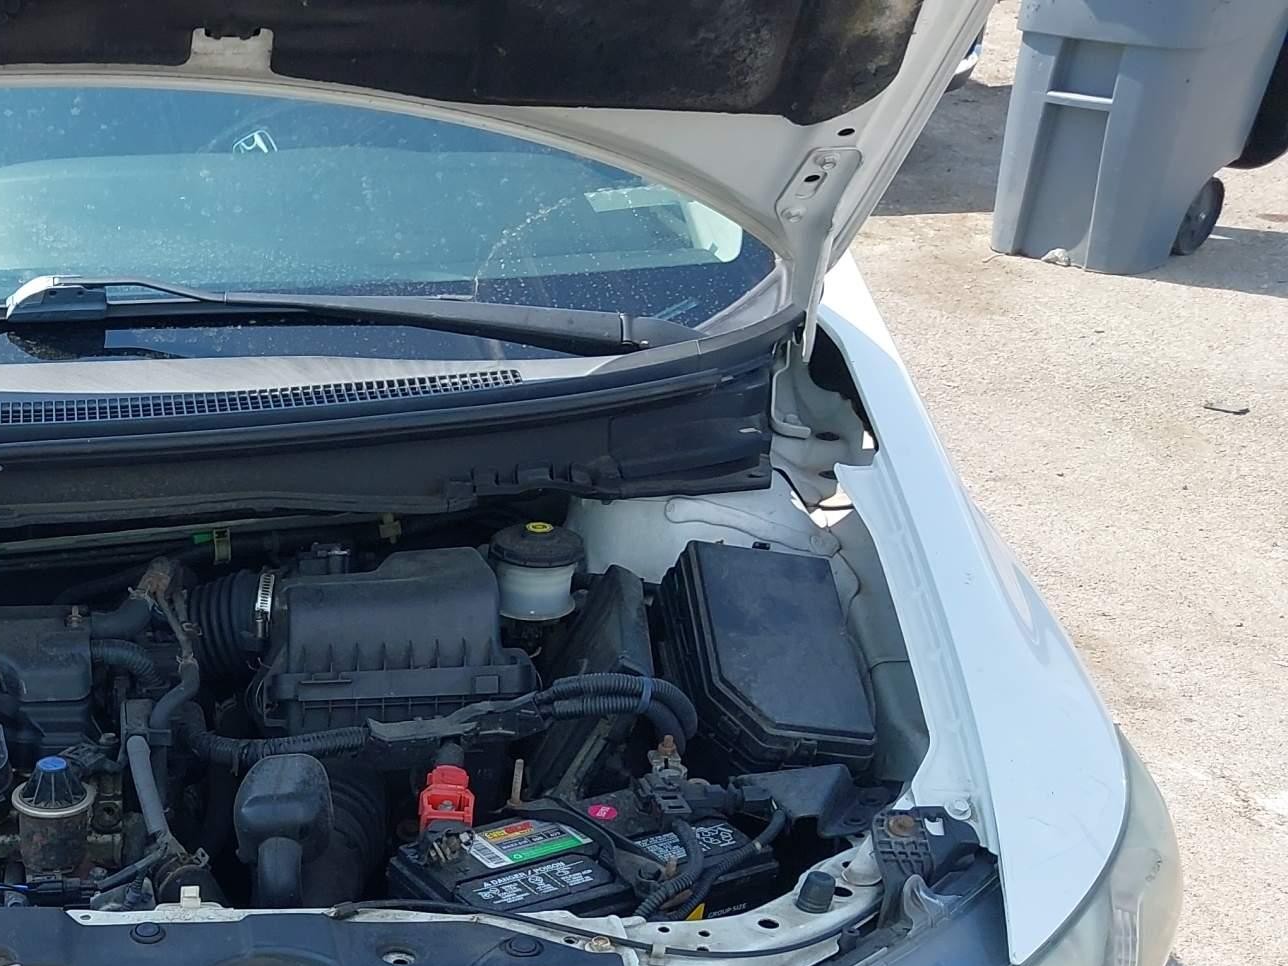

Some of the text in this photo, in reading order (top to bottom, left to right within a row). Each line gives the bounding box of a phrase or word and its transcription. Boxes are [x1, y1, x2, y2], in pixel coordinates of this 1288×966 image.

[533, 861, 566, 876] POISON
[707, 902, 748, 919] GROUP SIZE
